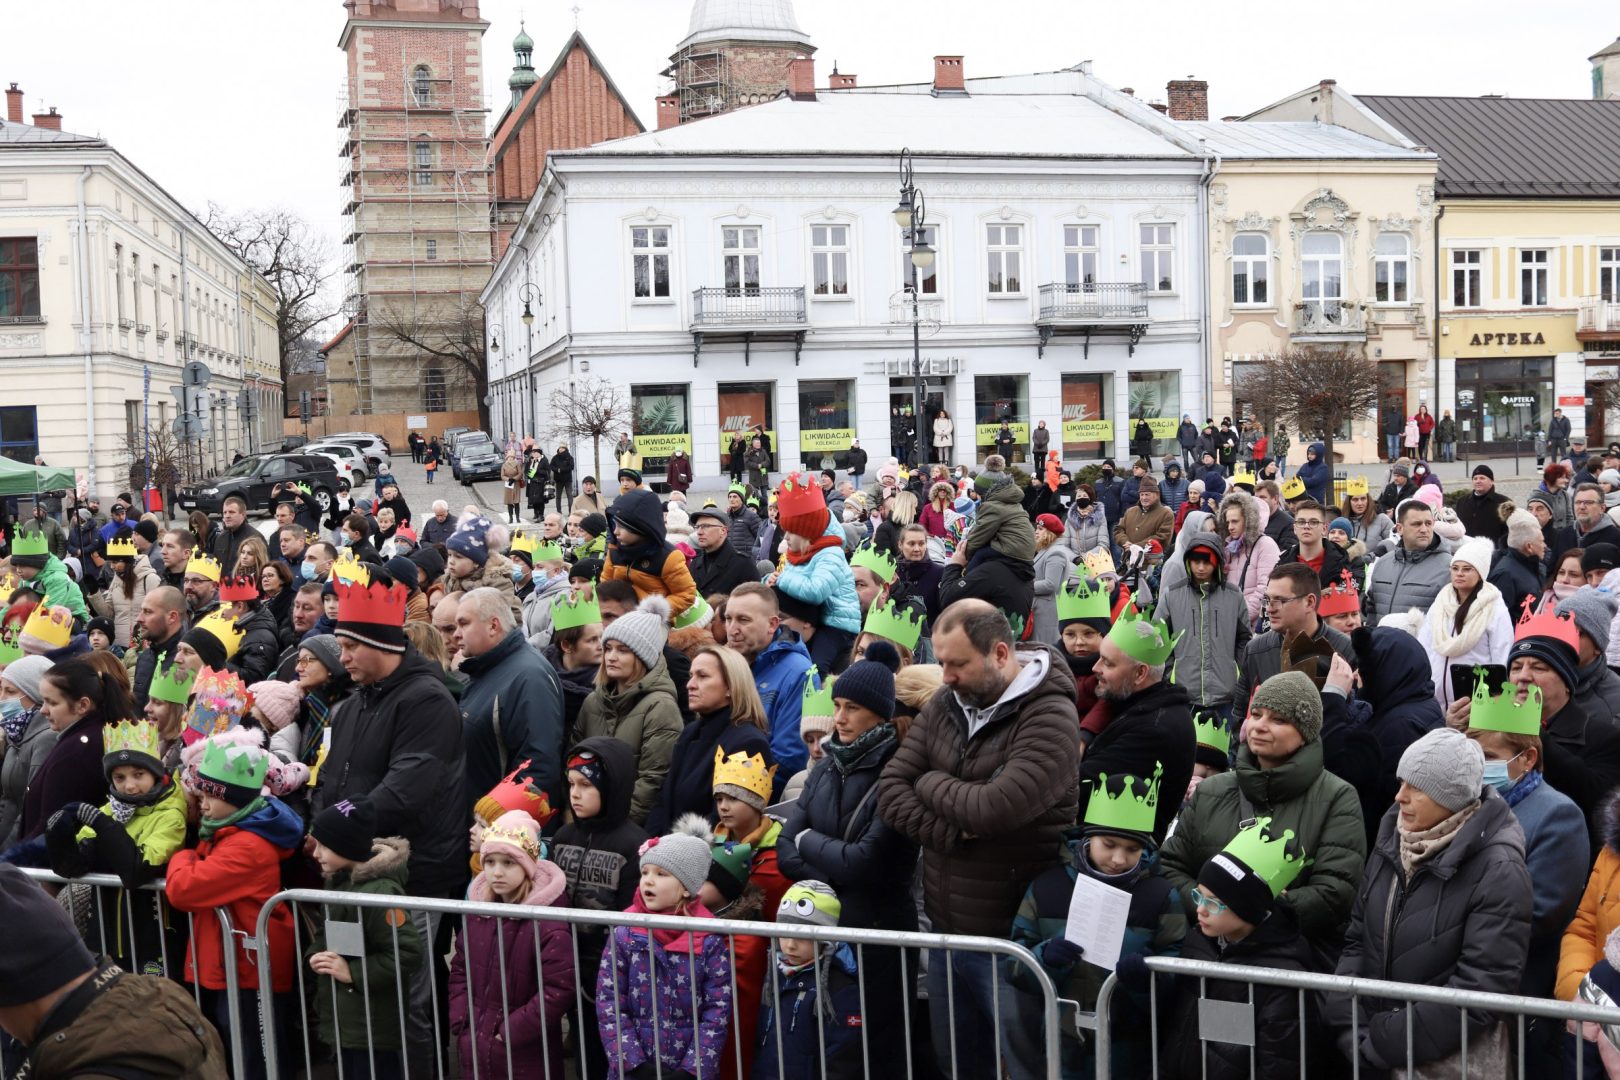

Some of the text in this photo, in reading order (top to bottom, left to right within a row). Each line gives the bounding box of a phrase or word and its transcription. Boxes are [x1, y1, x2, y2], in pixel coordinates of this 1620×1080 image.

[1469, 332, 1546, 346] APTEKA
[1063, 404, 1087, 418] NIKE
[724, 416, 752, 430] NIKE
[1066, 424, 1109, 432] LIKWIDACJA
[638, 437, 687, 446] LIKWIDACJA
[804, 432, 851, 440] LIKWIDACJA
